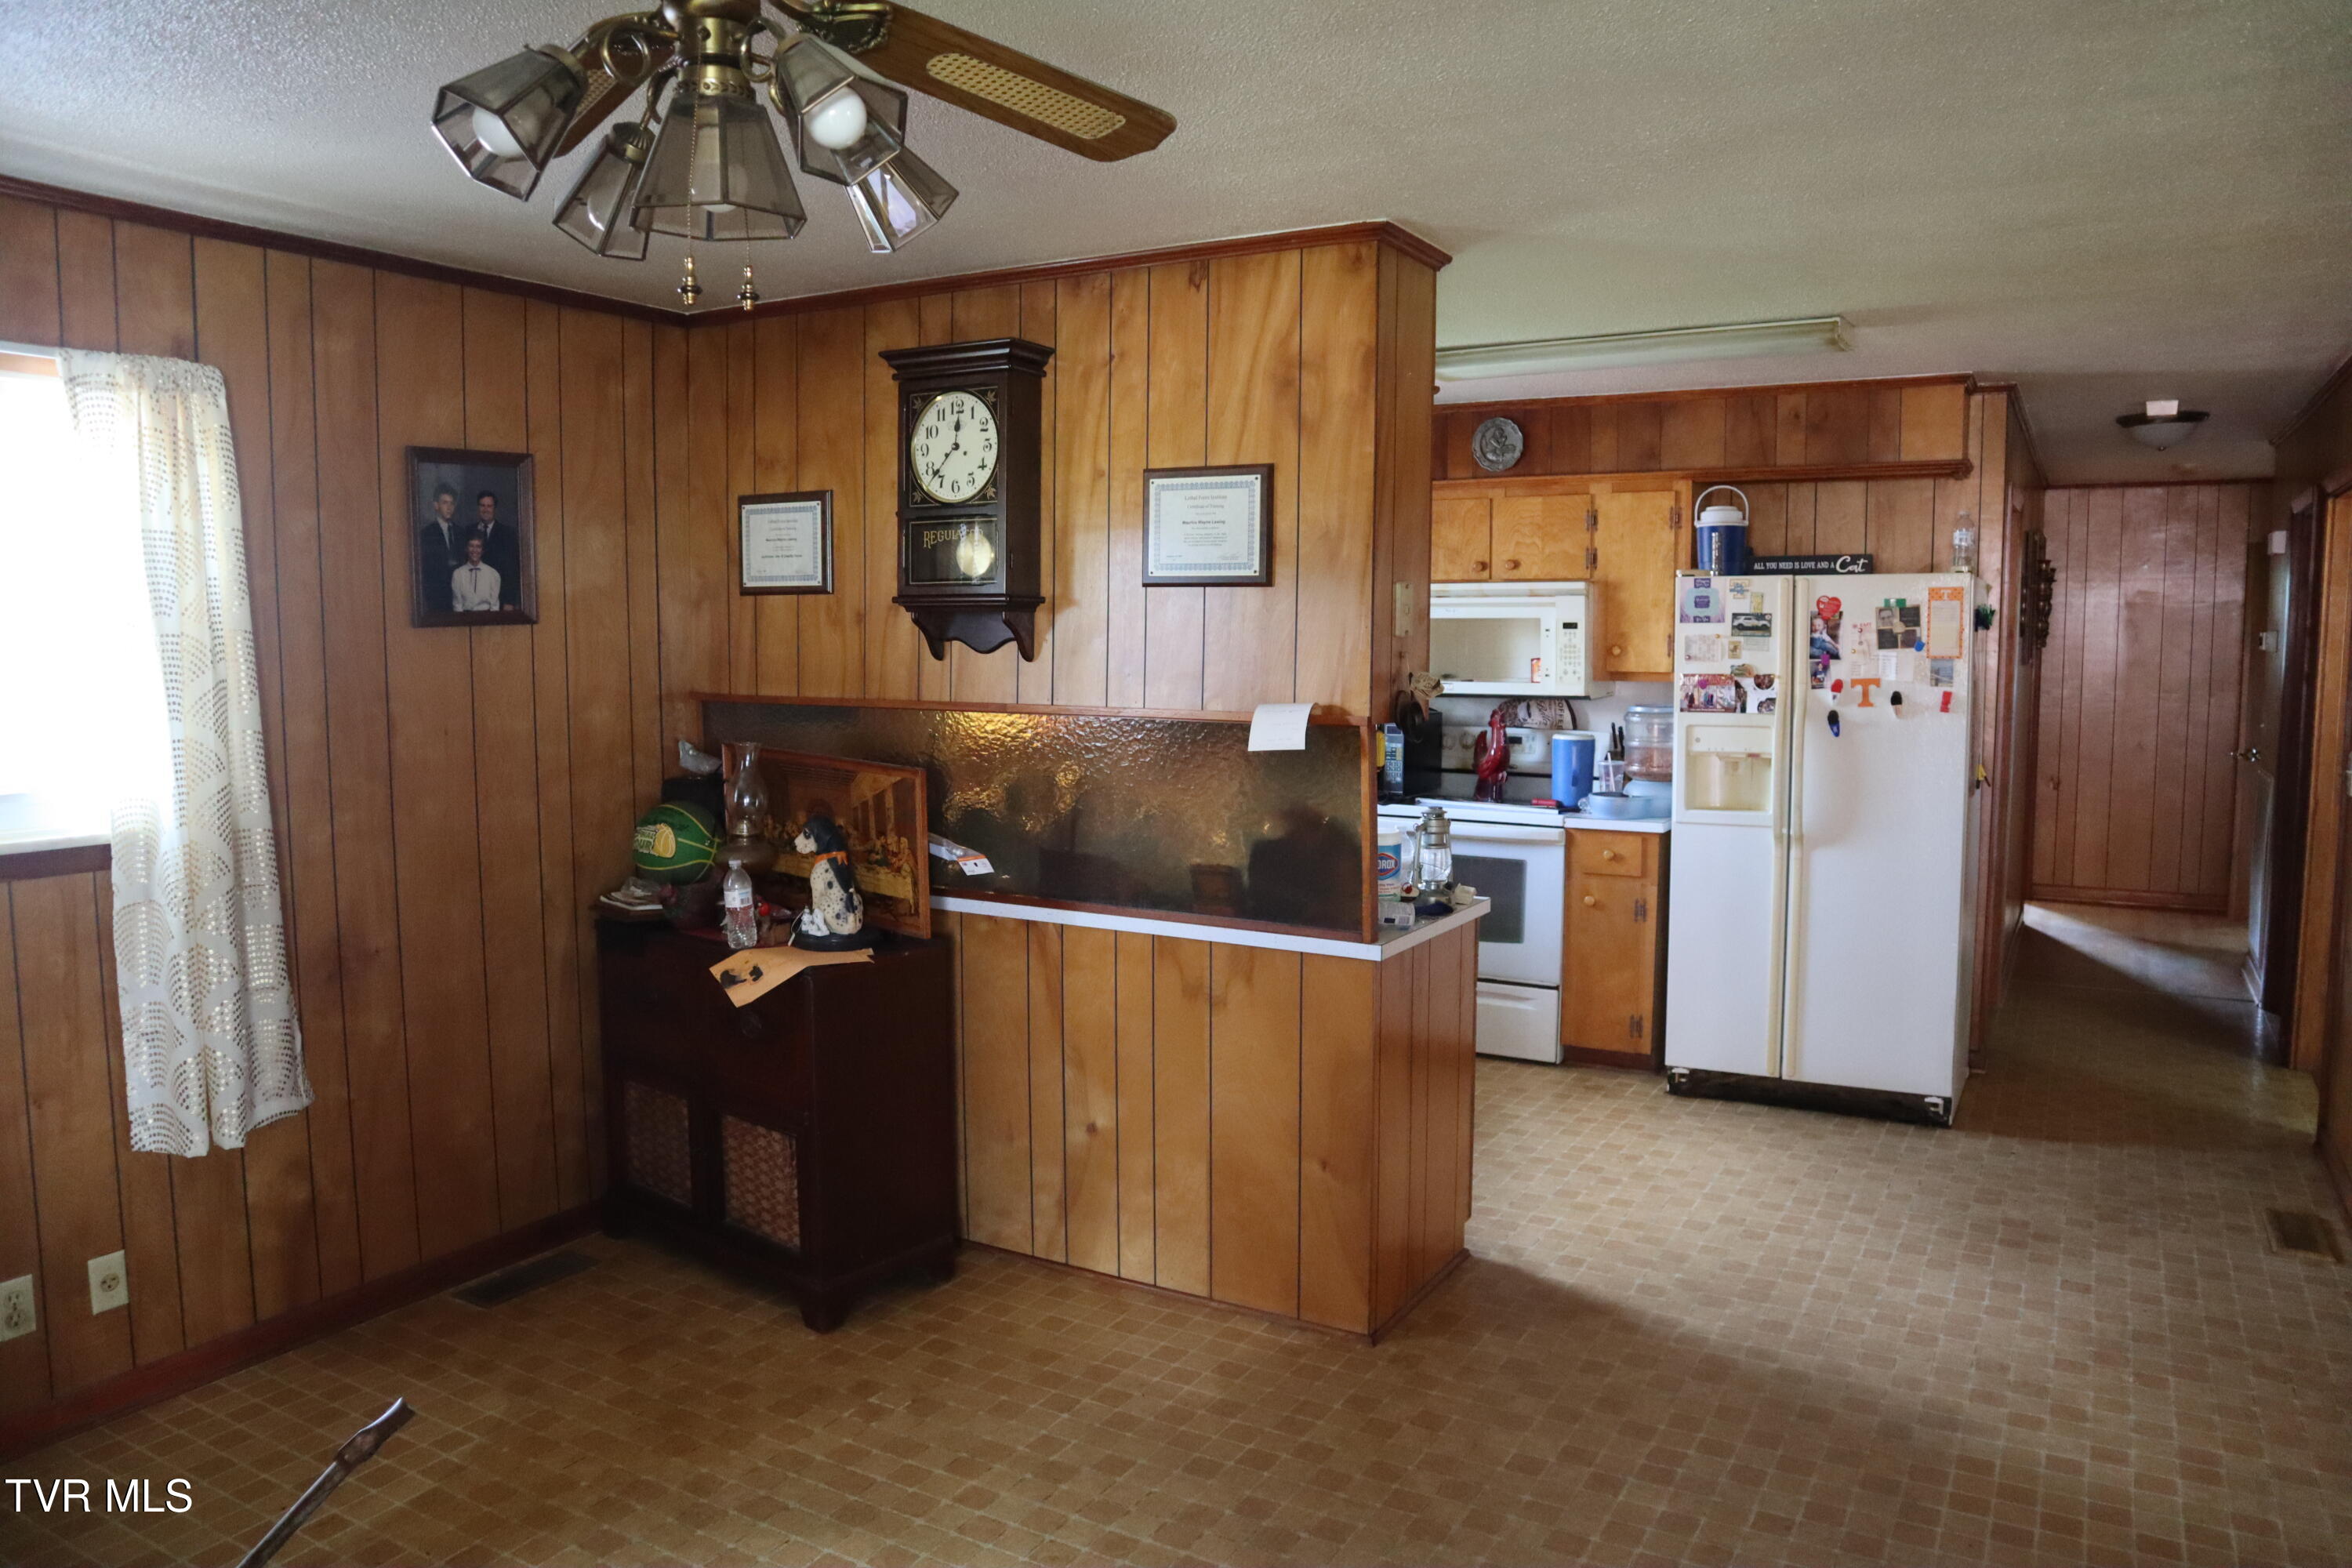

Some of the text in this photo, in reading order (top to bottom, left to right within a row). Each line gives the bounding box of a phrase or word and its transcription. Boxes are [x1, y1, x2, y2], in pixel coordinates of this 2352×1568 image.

[950, 399, 964, 415] 12
[970, 405, 975, 419] 1
[937, 408, 946, 422] 11
[979, 417, 989, 432] 2
[926, 425, 938, 439] 10
[920, 443, 930, 458] 9
[983, 439, 992, 452] 3
[926, 461, 935, 476] 8
[977, 457, 987, 471] 4
[938, 474, 946, 488] 7
[967, 472, 975, 487] 5
[951, 480, 960, 494] 6
[1754, 561, 1764, 570] ALL
[1835, 555, 1868, 573] Cat
[1850, 677, 1882, 707] T
[1377, 859, 1396, 869] OROX
